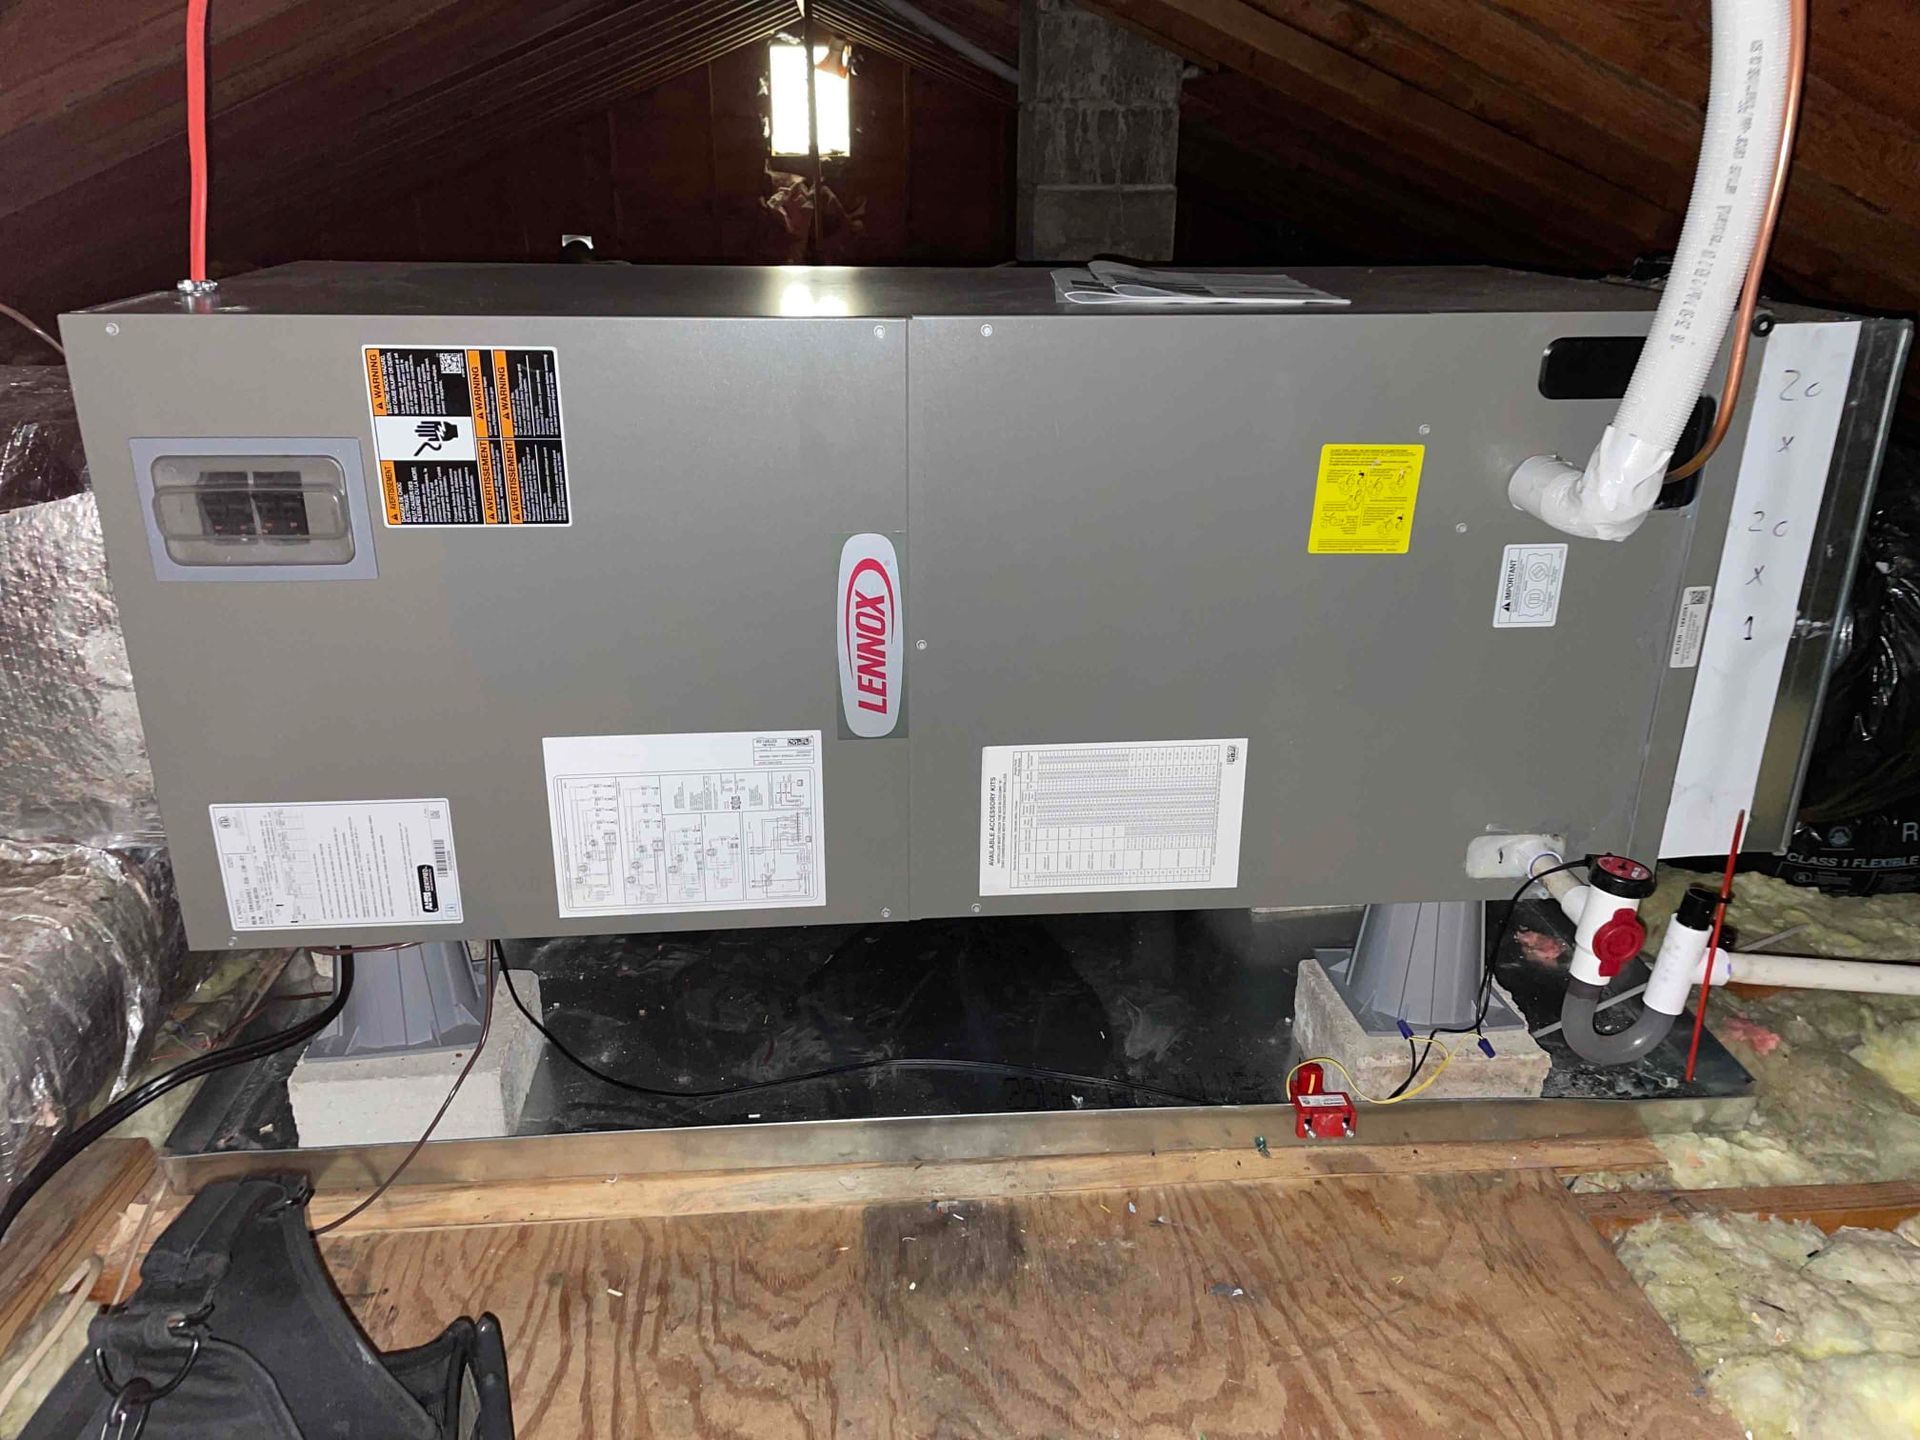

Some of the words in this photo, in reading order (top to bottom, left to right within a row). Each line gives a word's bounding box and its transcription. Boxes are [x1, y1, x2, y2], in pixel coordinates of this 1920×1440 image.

[369, 354, 382, 398] WARNING
[472, 367, 482, 410] WARNING
[498, 367, 508, 410] WARNING
[1779, 369, 1823, 401] 20
[385, 466, 397, 509] AVERTISSEMENT
[480, 442, 494, 510] AVERTISSEMENT
[506, 443, 519, 511] AVERTISSEMENT
[1504, 560, 1517, 601] IMPORTANT
[1743, 615, 1754, 641] 1
[854, 589, 887, 714] LENNOX
[1786, 852, 1838, 867] CLASS
[1842, 859, 1850, 867] 1
[1852, 855, 1920, 868] FLEXIBLE
